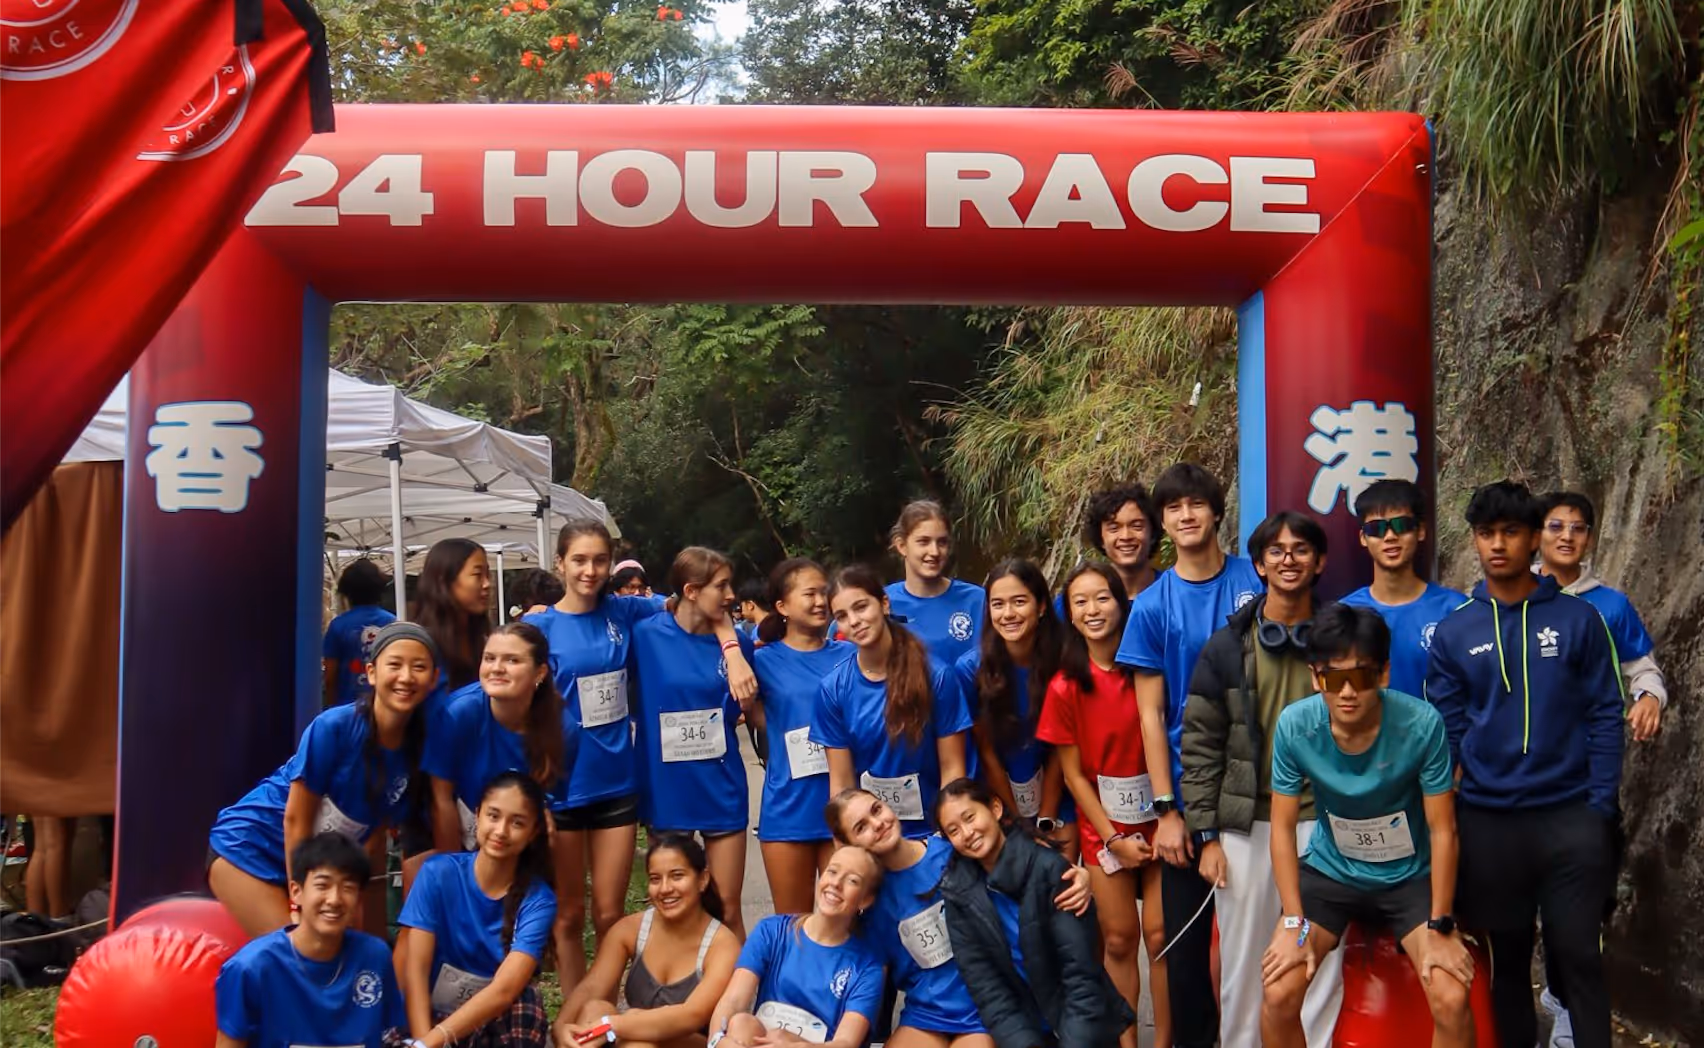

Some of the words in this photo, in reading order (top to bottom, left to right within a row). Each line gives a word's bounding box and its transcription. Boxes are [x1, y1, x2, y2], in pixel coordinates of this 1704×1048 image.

[8, 21, 84, 54] RACE
[244, 153, 435, 226] 24
[483, 149, 879, 228] HOUR
[925, 151, 1321, 233] RACE
[145, 400, 265, 513] 香
[1303, 400, 1418, 517] 港
[598, 686, 619, 705] 34-7
[681, 725, 706, 742] 34-6
[805, 741, 825, 756] 34-
[875, 789, 900, 804] 35-6
[1118, 790, 1144, 806] 34-1
[1354, 832, 1385, 846] 38-1
[916, 923, 944, 948] 35-1
